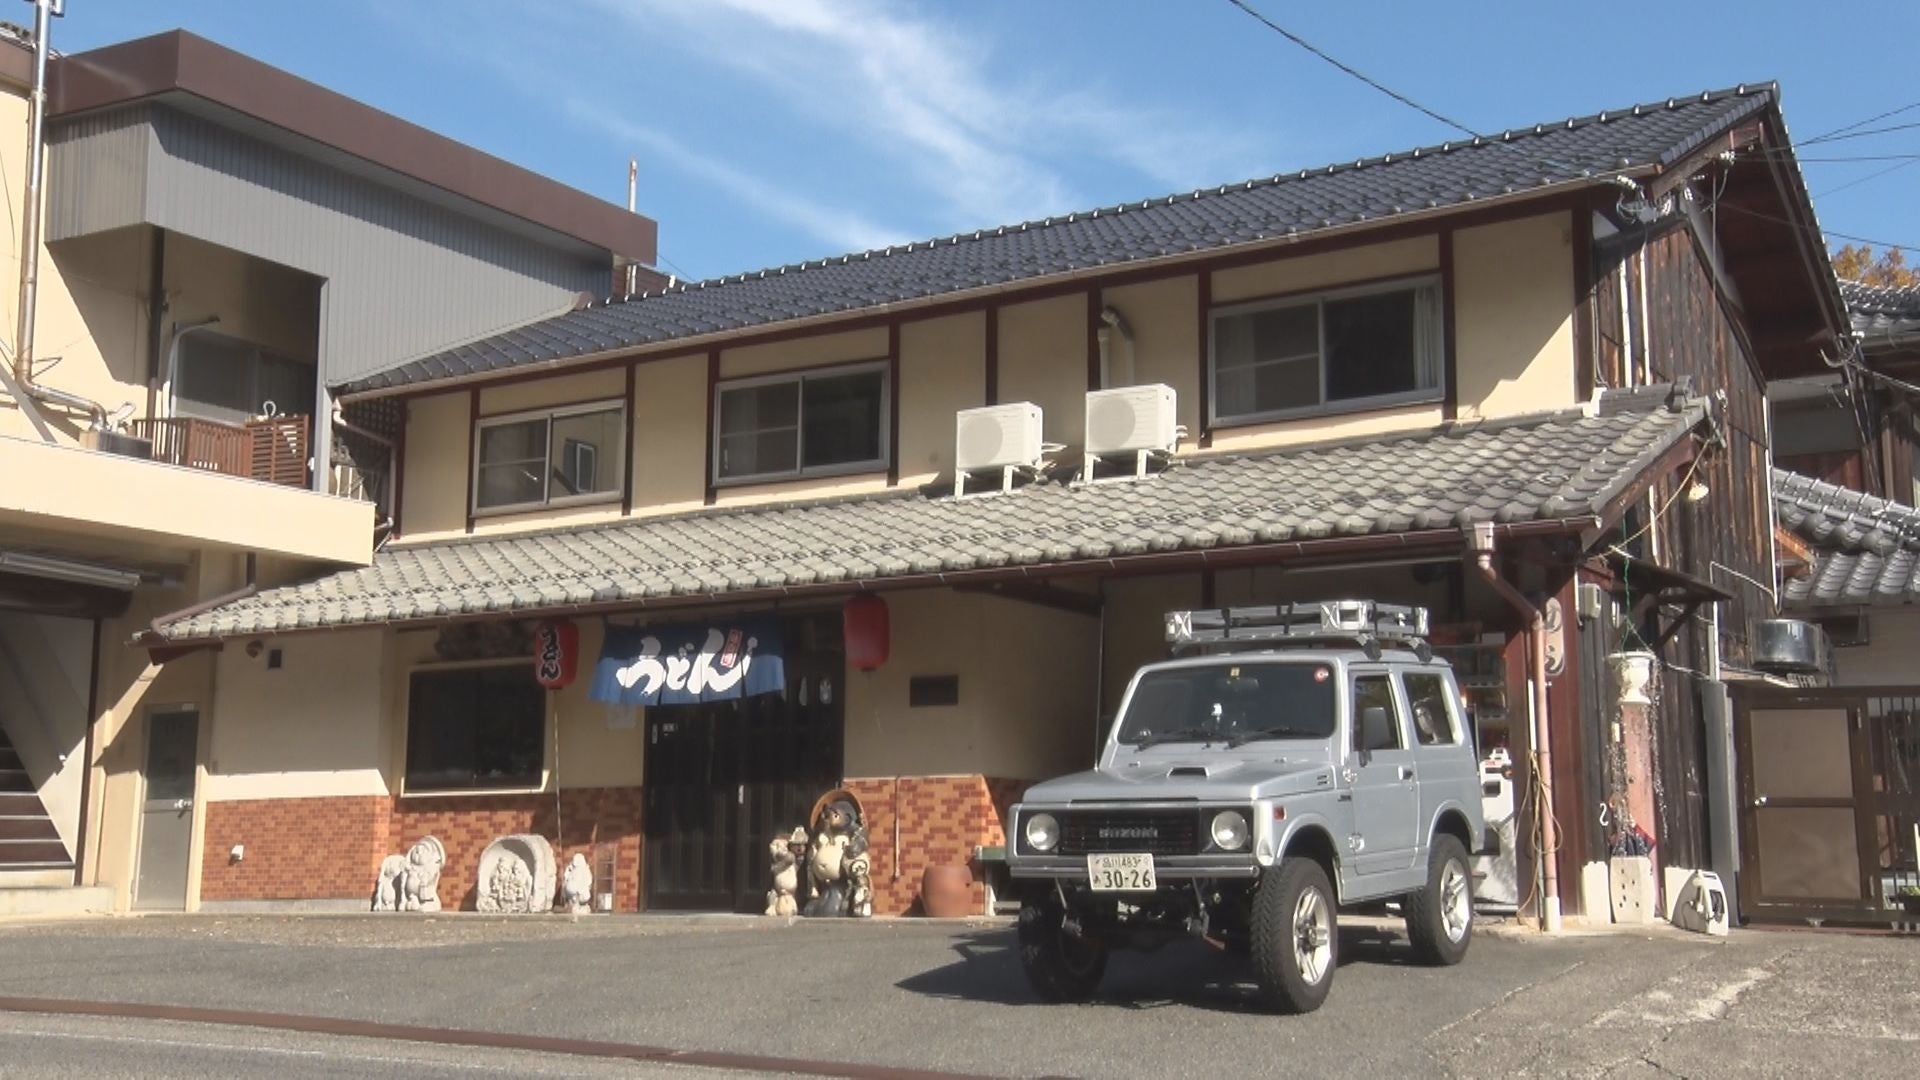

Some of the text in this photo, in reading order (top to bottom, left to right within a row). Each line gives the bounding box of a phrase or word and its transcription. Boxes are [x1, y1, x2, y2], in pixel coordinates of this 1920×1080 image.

[540, 624, 562, 680] うどん
[616, 627, 759, 697] うどん
[1102, 869, 1152, 889] 30-26
